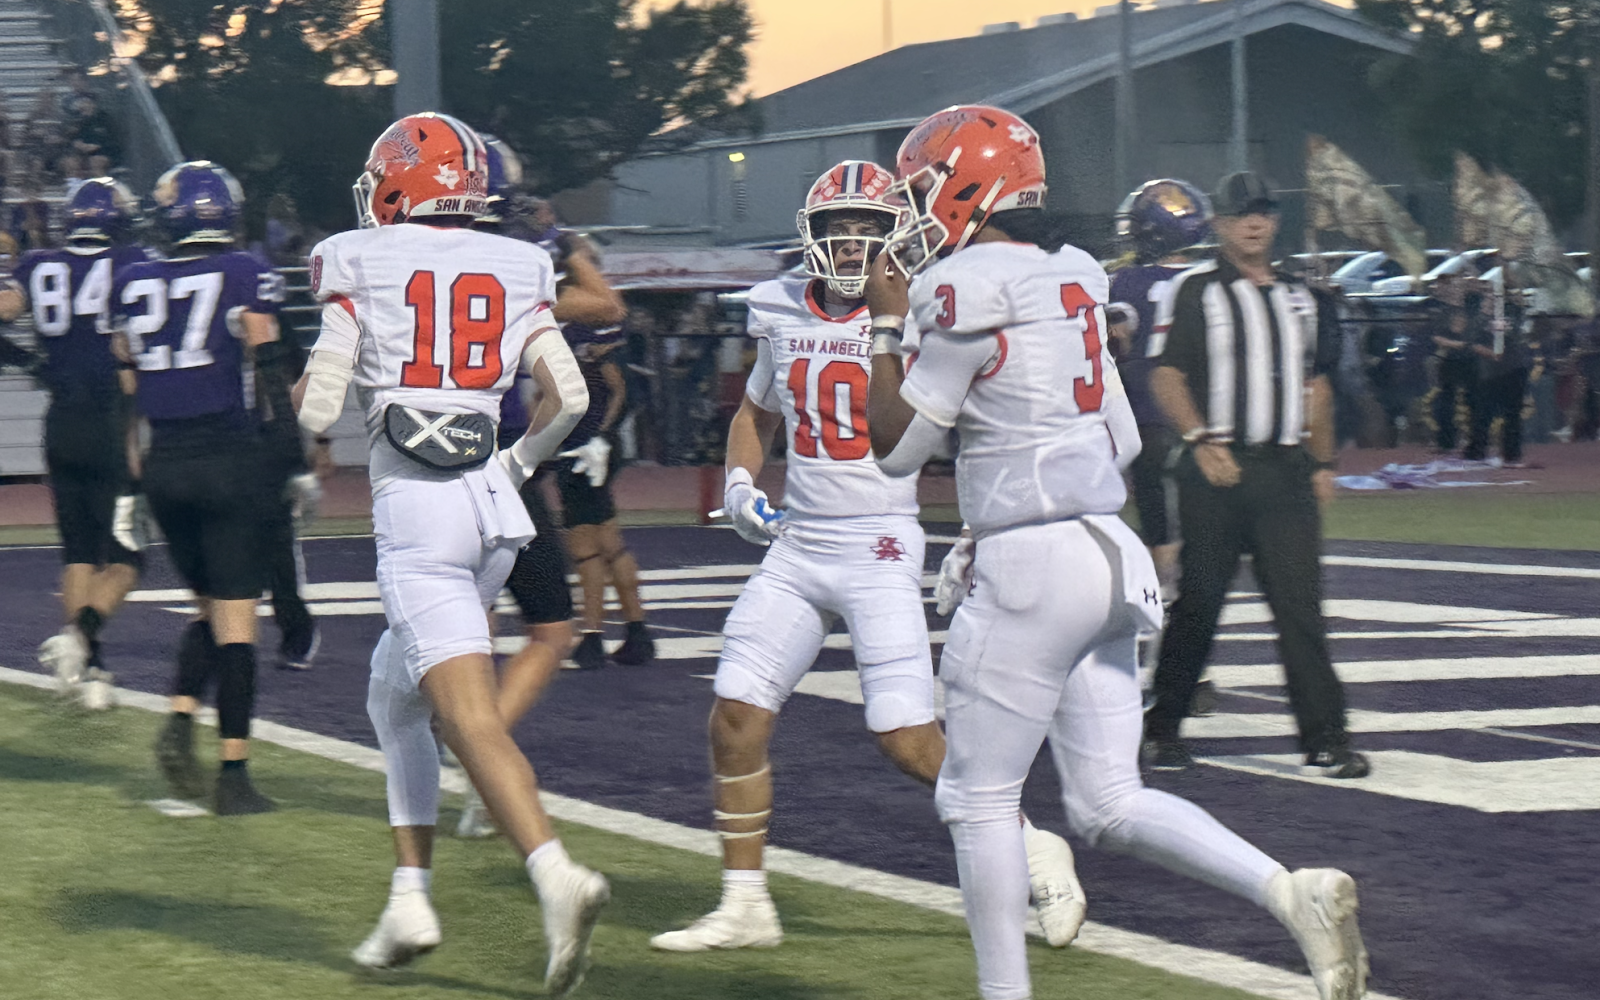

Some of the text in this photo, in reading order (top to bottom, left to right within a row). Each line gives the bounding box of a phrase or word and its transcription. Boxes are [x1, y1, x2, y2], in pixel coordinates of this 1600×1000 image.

[435, 199, 460, 212] SAN
[30, 258, 117, 336] 84
[121, 272, 225, 371] 27
[399, 269, 506, 389] 18
[935, 284, 956, 328] 3
[788, 339, 816, 354] SAN
[1060, 282, 1105, 414] 3
[787, 357, 871, 461] 10
